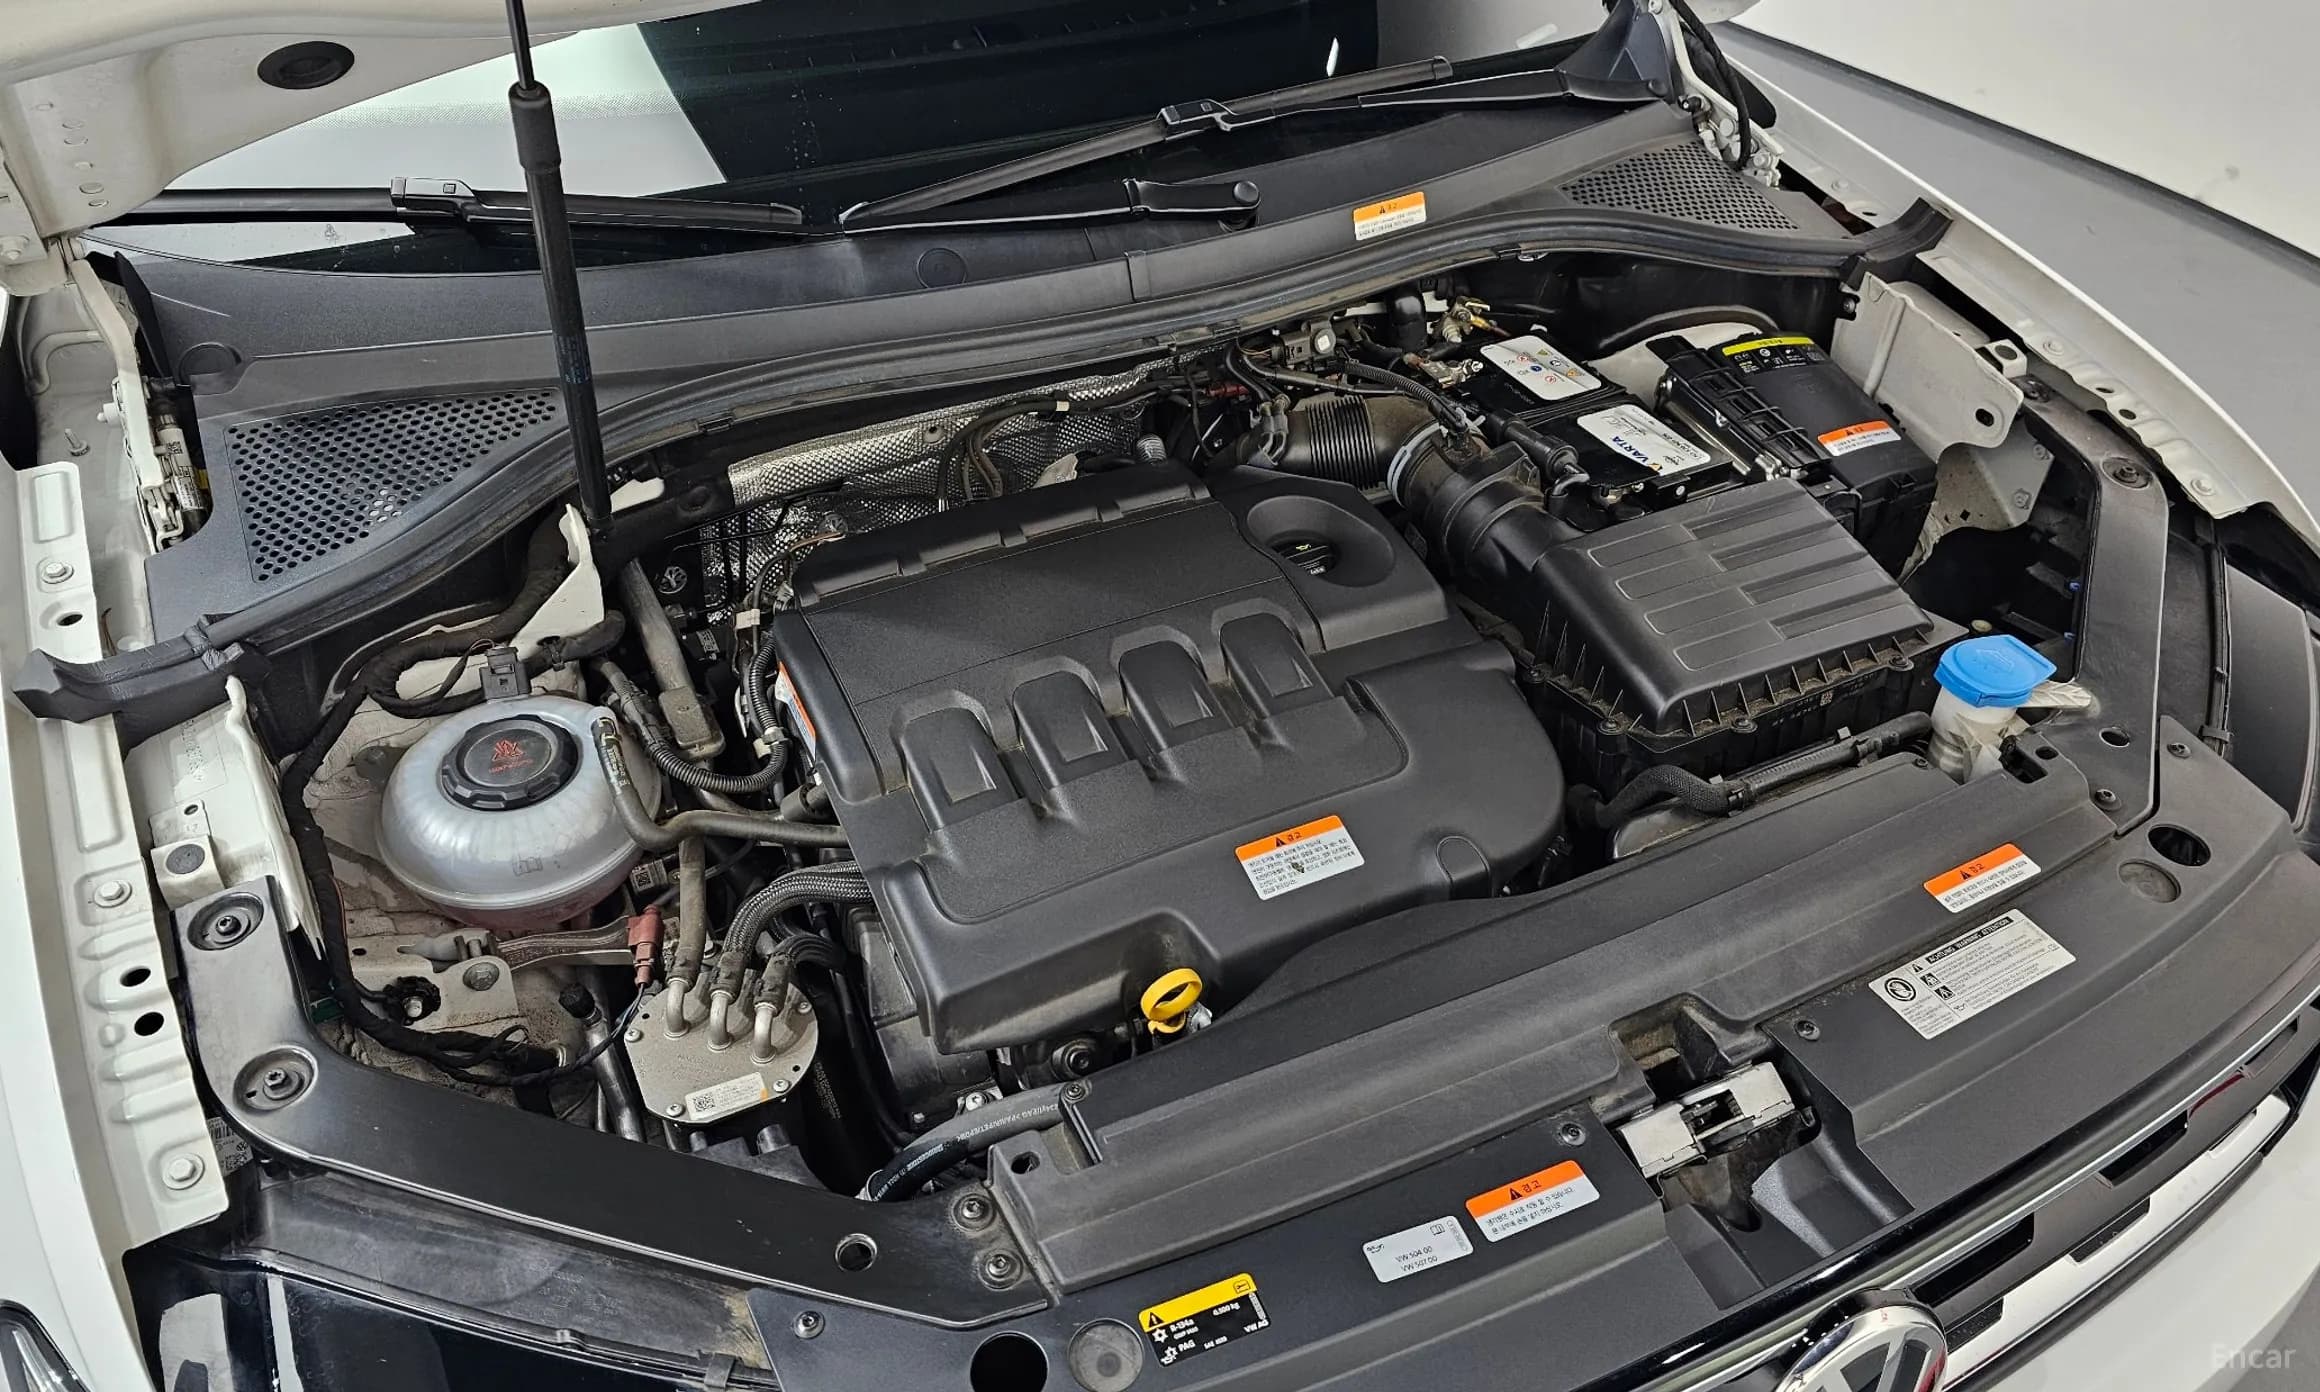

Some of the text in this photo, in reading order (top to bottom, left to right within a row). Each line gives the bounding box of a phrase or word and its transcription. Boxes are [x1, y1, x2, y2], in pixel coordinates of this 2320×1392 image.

[1612, 436, 1649, 463] VARTA
[1521, 1179, 1541, 1193] 경고
[1395, 1253, 1409, 1263] VW
[1422, 1245, 1433, 1254] 00
[1400, 1262, 1414, 1272] VW
[1230, 1302, 1241, 1311] kg
[1243, 1322, 1257, 1333] VW
[1178, 1339, 1196, 1352] PAG
